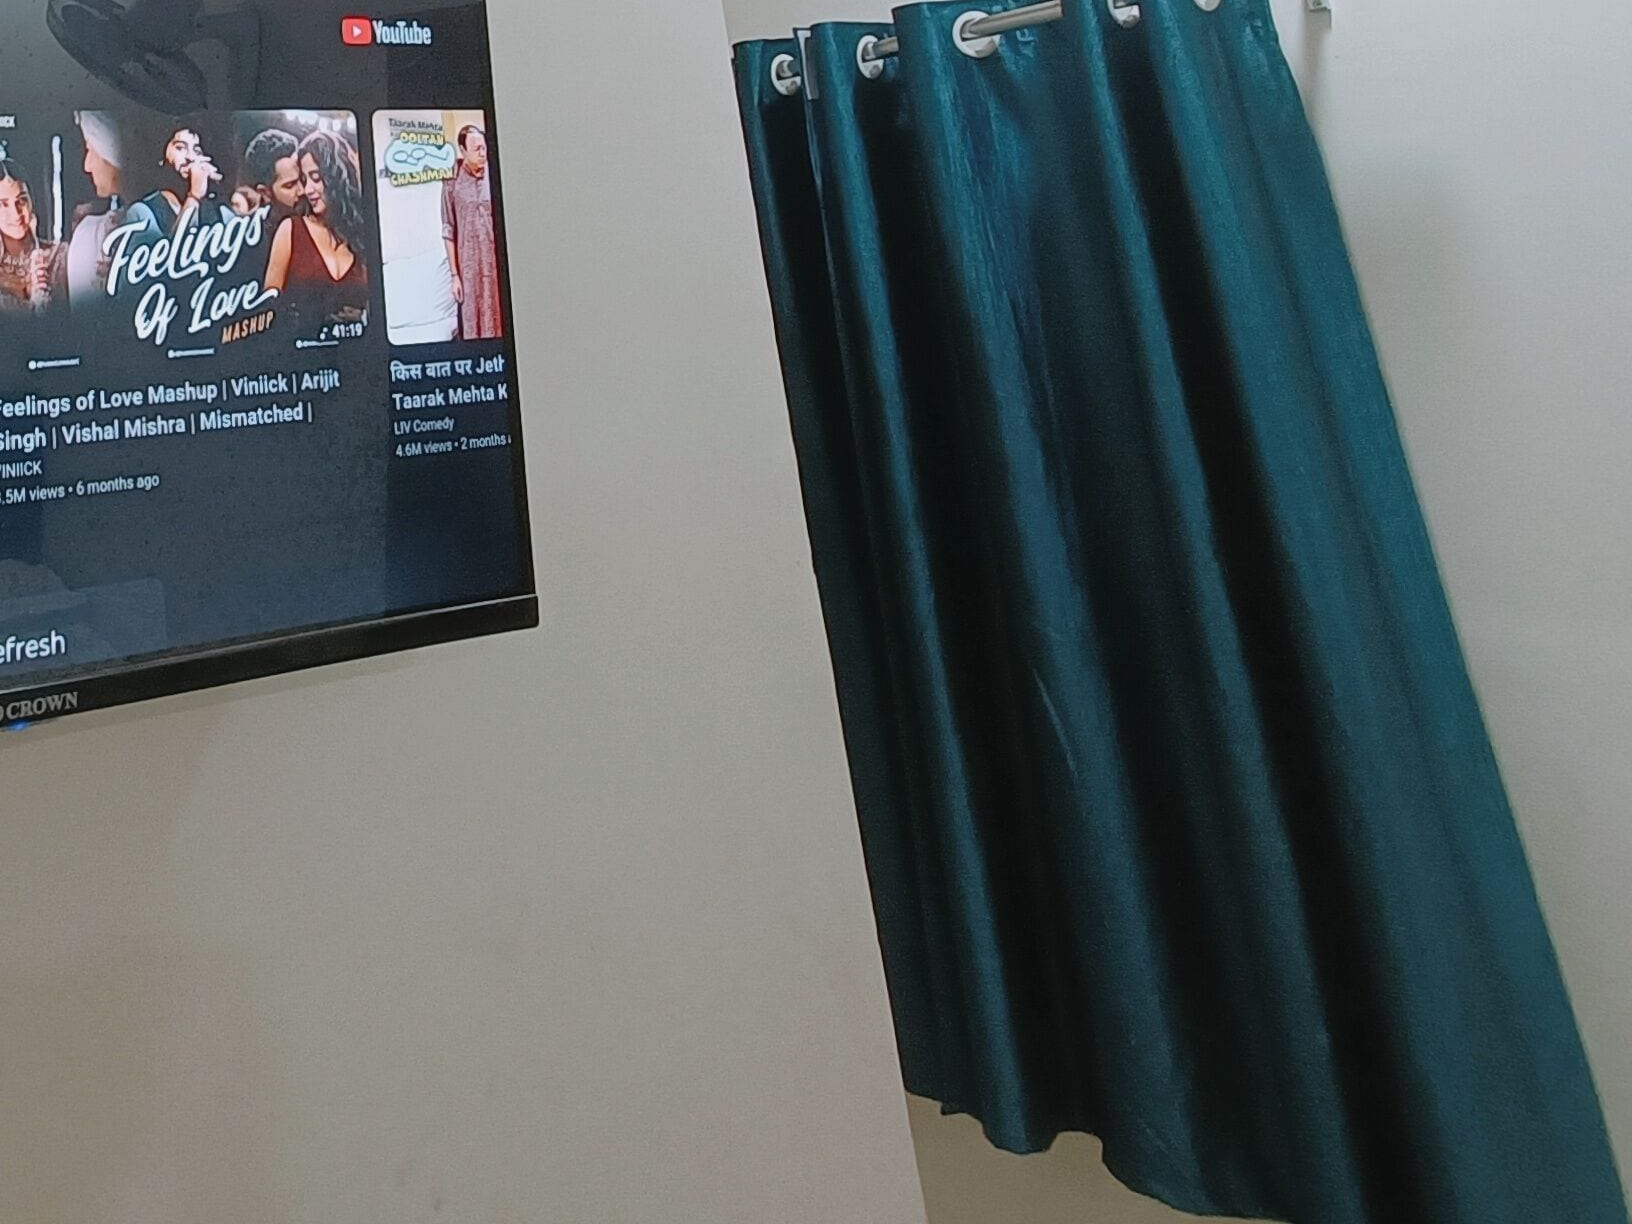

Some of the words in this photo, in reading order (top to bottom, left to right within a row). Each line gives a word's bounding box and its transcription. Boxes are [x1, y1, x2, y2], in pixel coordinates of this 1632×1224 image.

[372, 19, 432, 44] YouTube
[103, 204, 272, 296] Feelings
[134, 282, 179, 346] Of
[187, 277, 280, 335] Love
[221, 310, 275, 344] MASHUP
[331, 323, 363, 338] 41:19
[389, 360, 422, 382] किस
[454, 359, 473, 375] पर
[75, 389, 96, 411] of
[100, 389, 144, 409] Love
[148, 381, 218, 405] Mashup
[231, 373, 288, 397] Viniick
[301, 369, 340, 393] Arijit
[392, 387, 446, 411] Taarak
[448, 384, 495, 405] Mehta
[61, 419, 119, 445] Vishal
[124, 414, 186, 439] Mishra
[199, 401, 304, 431] Mismatched
[413, 416, 455, 434] Comedy
[395, 441, 423, 458] 4.6M
[423, 440, 453, 455] views
[460, 436, 468, 451] 2
[469, 433, 507, 449] months
[29, 484, 66, 502] views
[75, 480, 85, 496] 6
[86, 476, 134, 495] months
[136, 474, 160, 491] ago
[5, 691, 79, 720] CROWN
